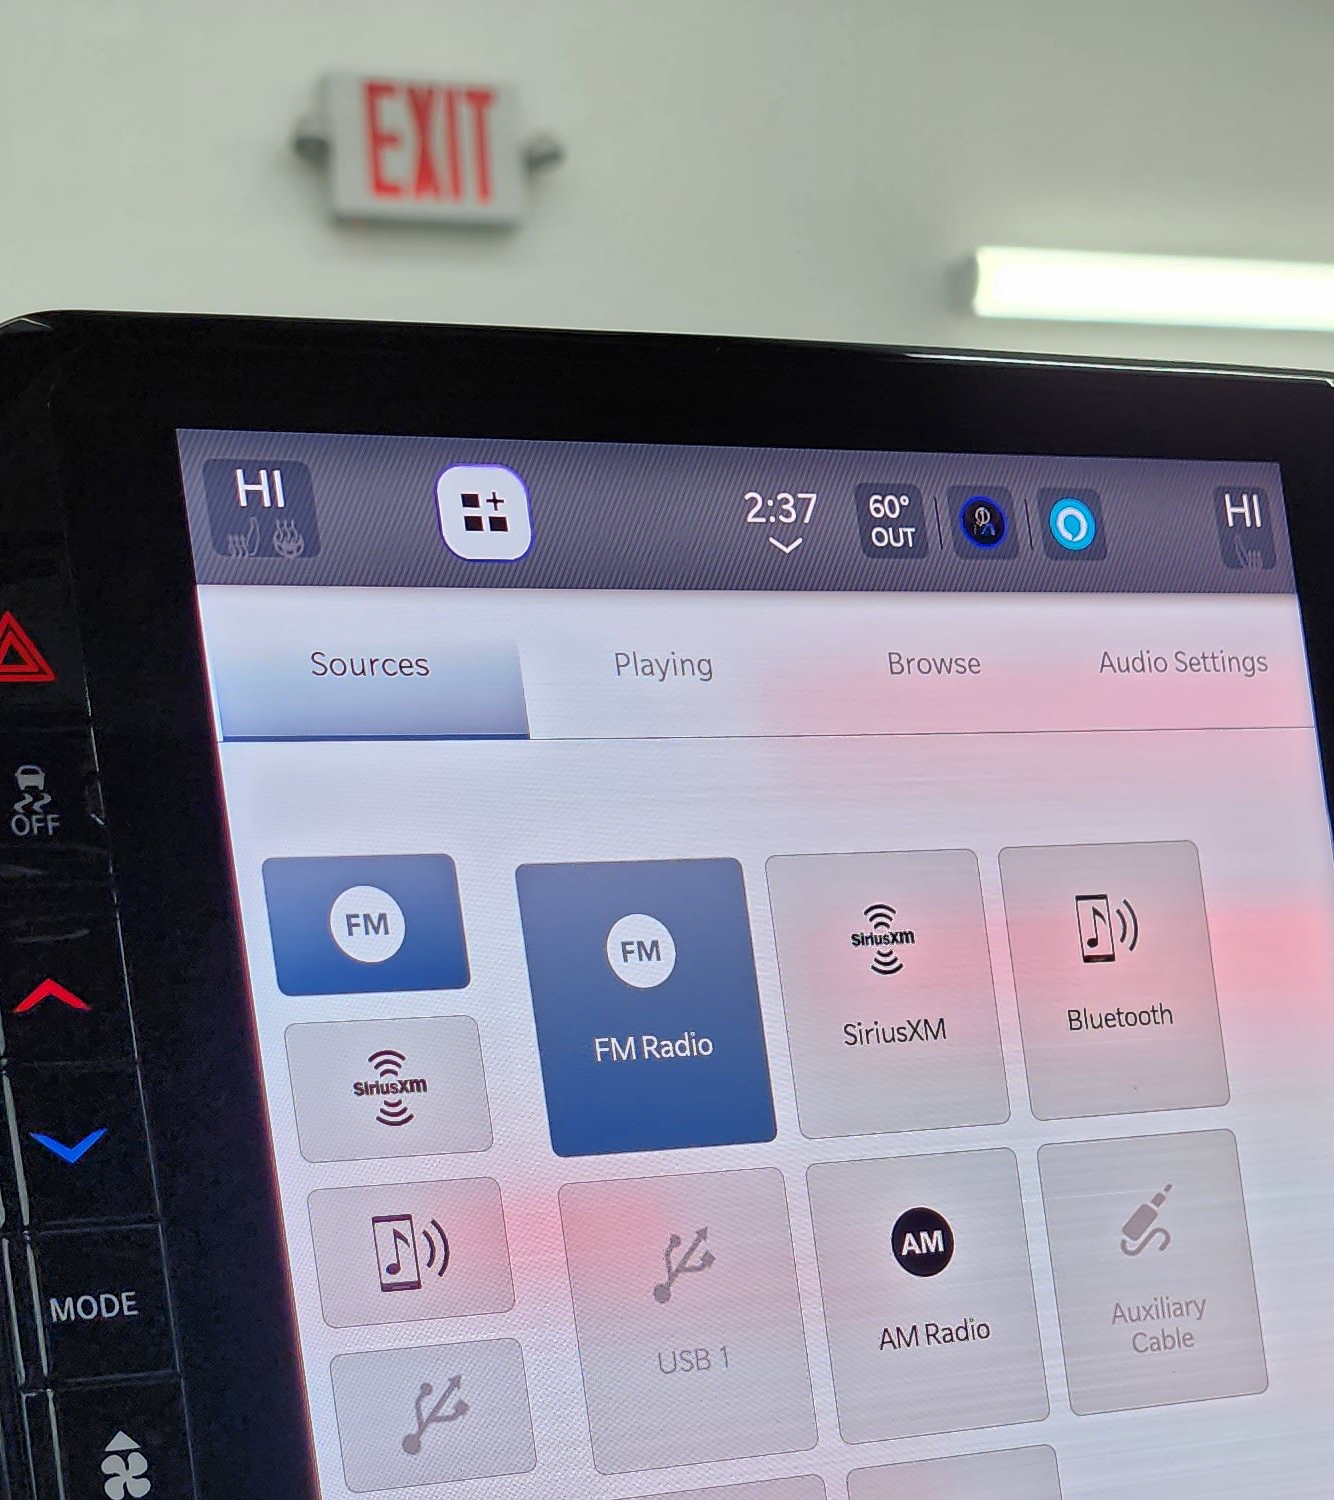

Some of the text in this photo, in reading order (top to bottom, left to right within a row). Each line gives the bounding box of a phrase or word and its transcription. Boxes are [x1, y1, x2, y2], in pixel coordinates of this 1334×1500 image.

[363, 81, 497, 205] EXIT
[235, 468, 285, 508] HI
[744, 491, 818, 525] 2:37
[869, 494, 910, 520] 60°
[1224, 493, 1263, 528] HI
[871, 526, 916, 549] OUT
[310, 651, 431, 678] Sources
[615, 651, 713, 681] Playing
[888, 652, 982, 676] Browse
[1099, 649, 1269, 677] Audio Settings
[10, 812, 60, 838] OFF
[345, 912, 391, 937] FM
[620, 939, 662, 963] FM
[1067, 1003, 1174, 1032] Bluetooth
[595, 1031, 714, 1062] FM Radio
[843, 1018, 947, 1047] SiriusXM
[901, 1229, 945, 1255] AM
[49, 1291, 139, 1324] MODE
[1111, 1292, 1208, 1328] Auxiliary
[879, 1317, 991, 1353] AM Radio
[1131, 1326, 1195, 1356] Cable
[657, 1346, 730, 1377] USB 1
